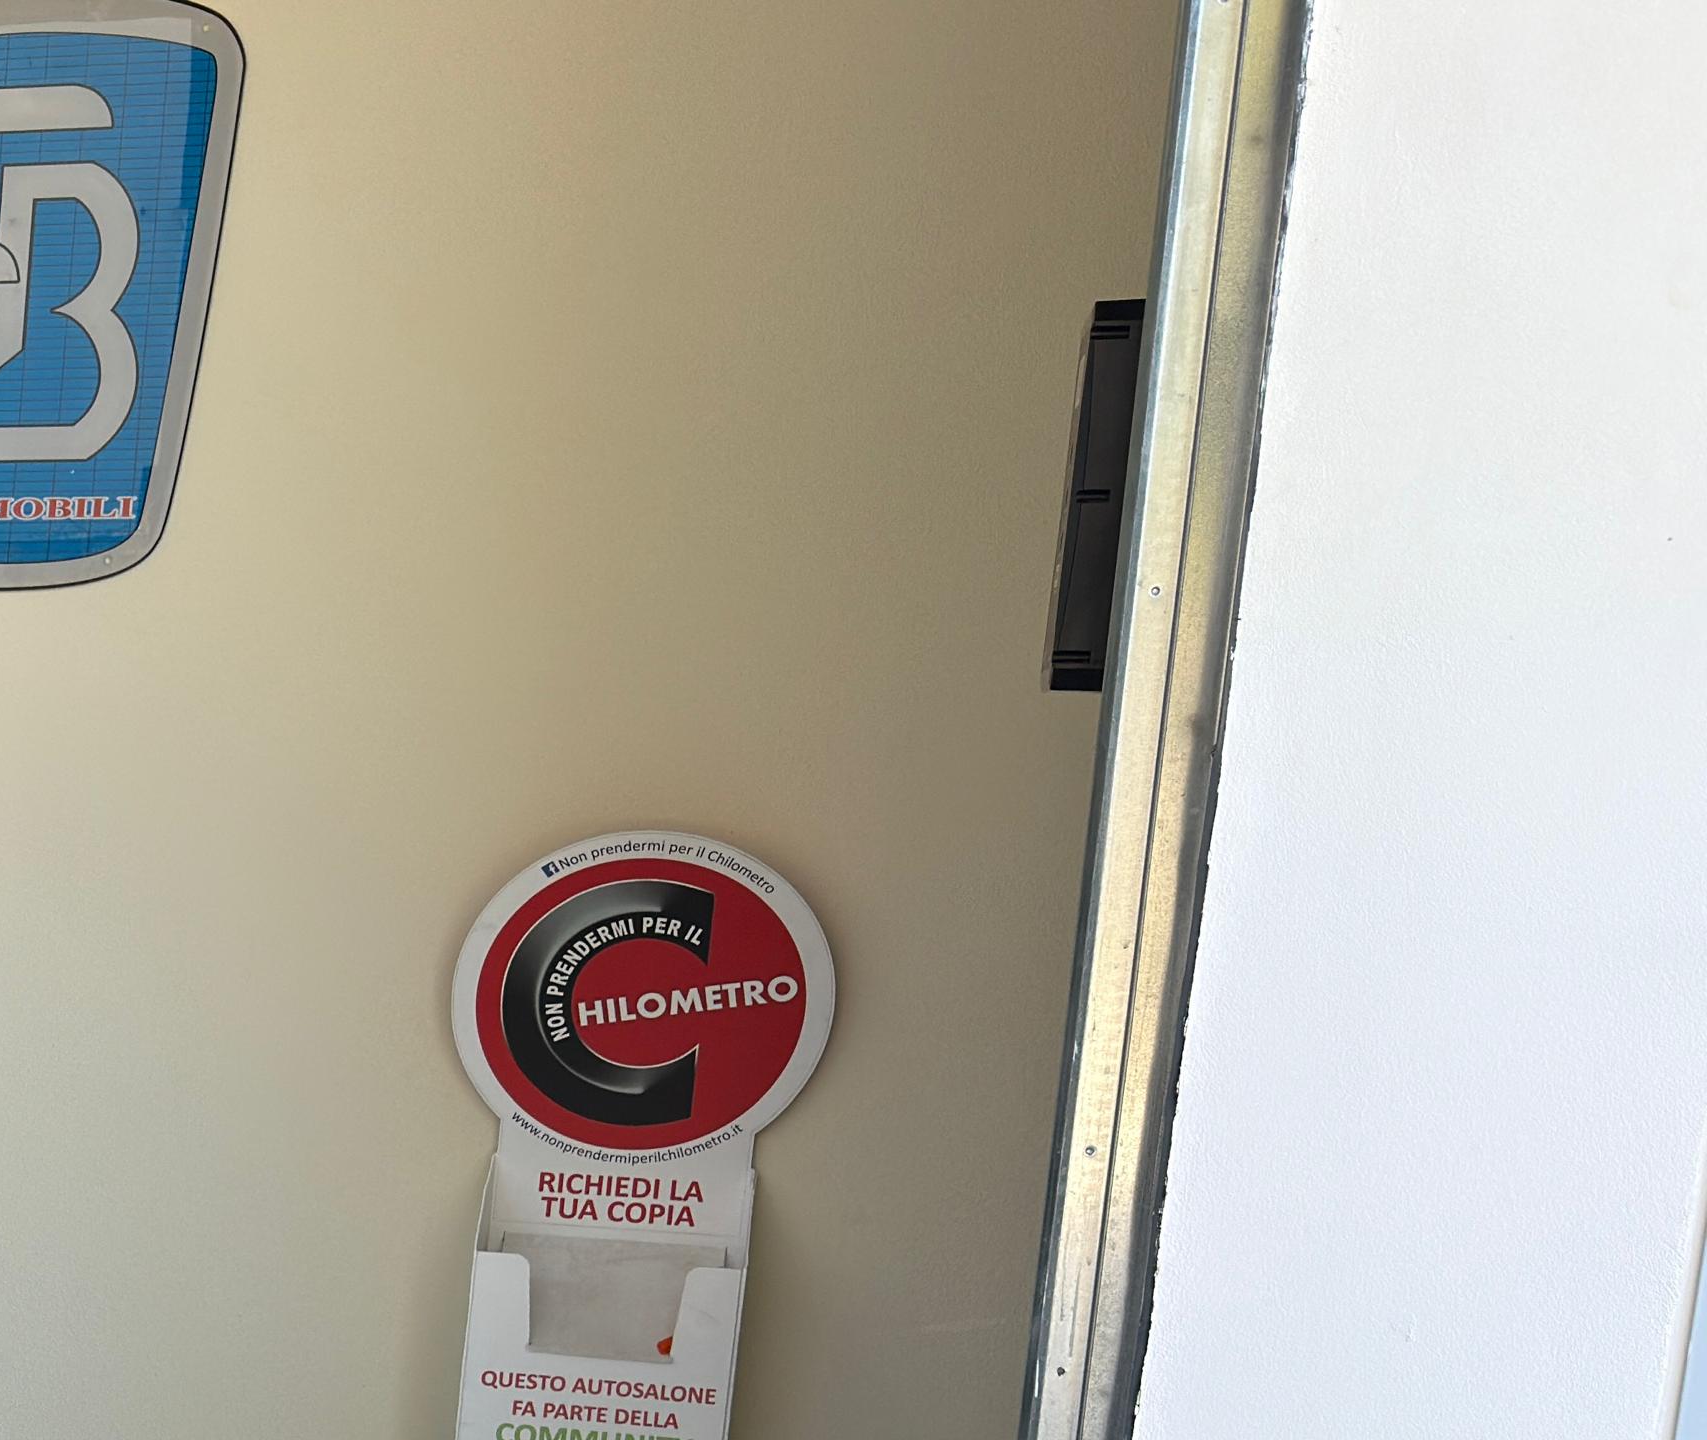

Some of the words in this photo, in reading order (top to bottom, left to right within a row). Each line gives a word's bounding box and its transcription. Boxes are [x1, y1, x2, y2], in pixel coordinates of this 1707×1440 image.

[558, 852, 588, 870] Non
[591, 841, 666, 860] prendermi
[668, 843, 694, 855] per
[696, 846, 706, 859] il
[707, 851, 775, 895] Chilometro
[642, 917, 682, 936] PER
[684, 925, 703, 946] IL
[546, 918, 635, 997] PRENDERMI
[545, 1003, 570, 1042] NON
[511, 1111, 744, 1166] www.nonprendermiperilchilometro.it
[538, 1172, 660, 1199] RICHIEDI
[670, 1179, 703, 1202] LA
[541, 1196, 598, 1221] TUA
[607, 1201, 695, 1228] COPIA
[481, 1370, 566, 1392] QUESTO
[572, 1378, 717, 1405] AUTOSALONE
[511, 1401, 536, 1418] FA
[543, 1404, 608, 1423] PARTE
[614, 1409, 679, 1430] DELLA
